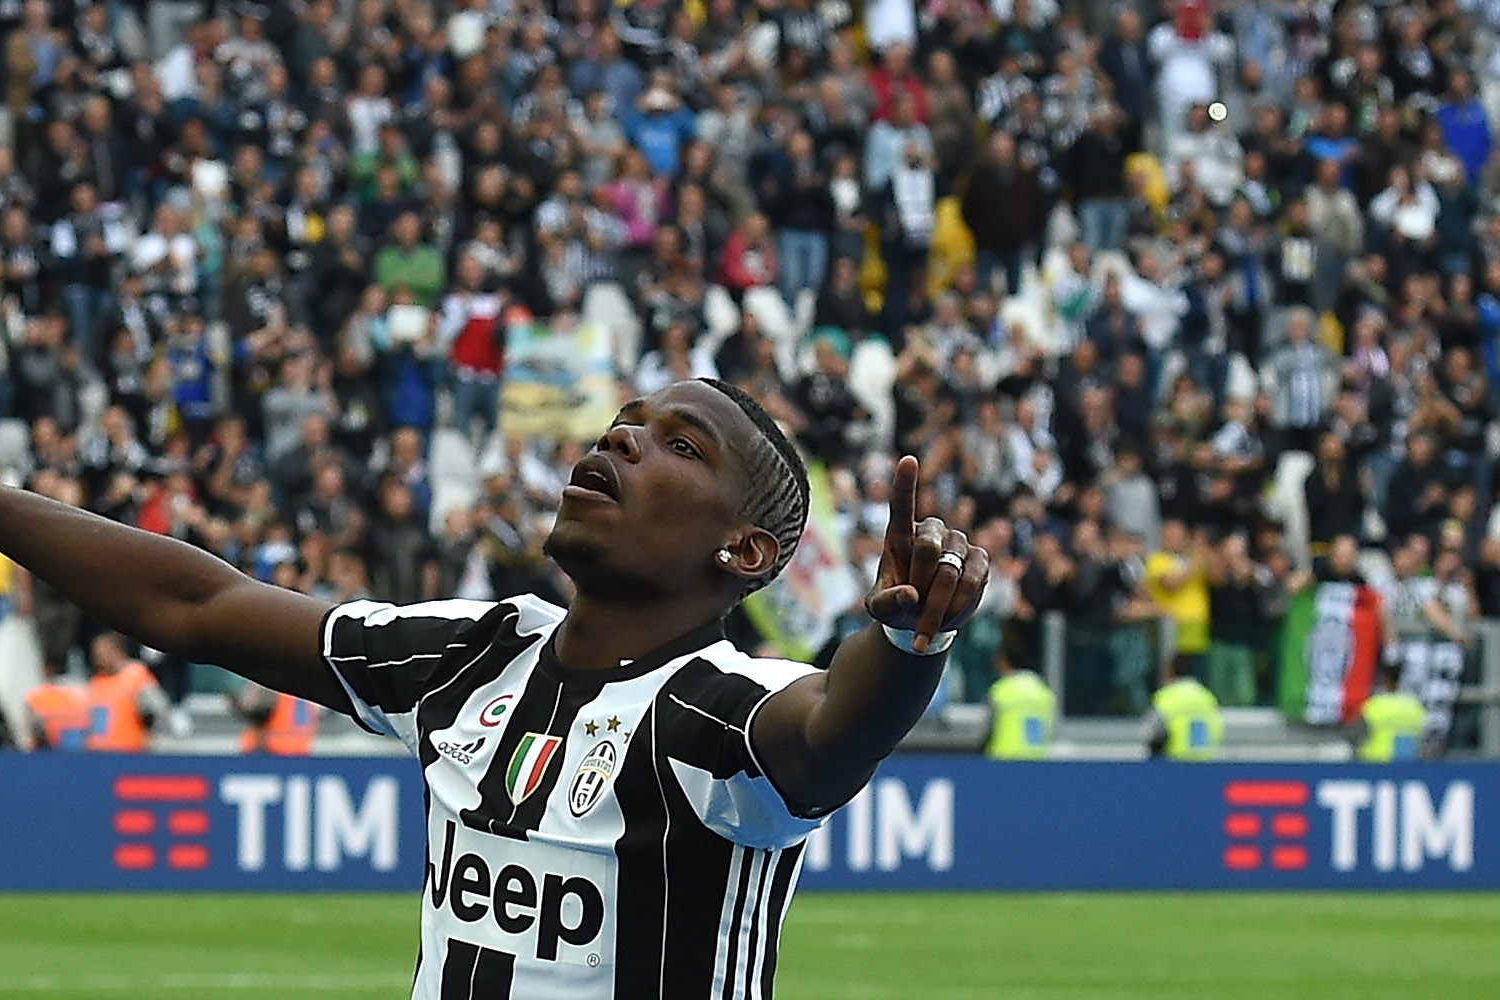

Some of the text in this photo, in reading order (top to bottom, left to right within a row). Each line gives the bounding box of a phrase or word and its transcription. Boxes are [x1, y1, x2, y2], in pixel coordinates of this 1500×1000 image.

[220, 774, 398, 871] TIM
[1317, 780, 1475, 871] TIM
[430, 820, 604, 961] Jeep
